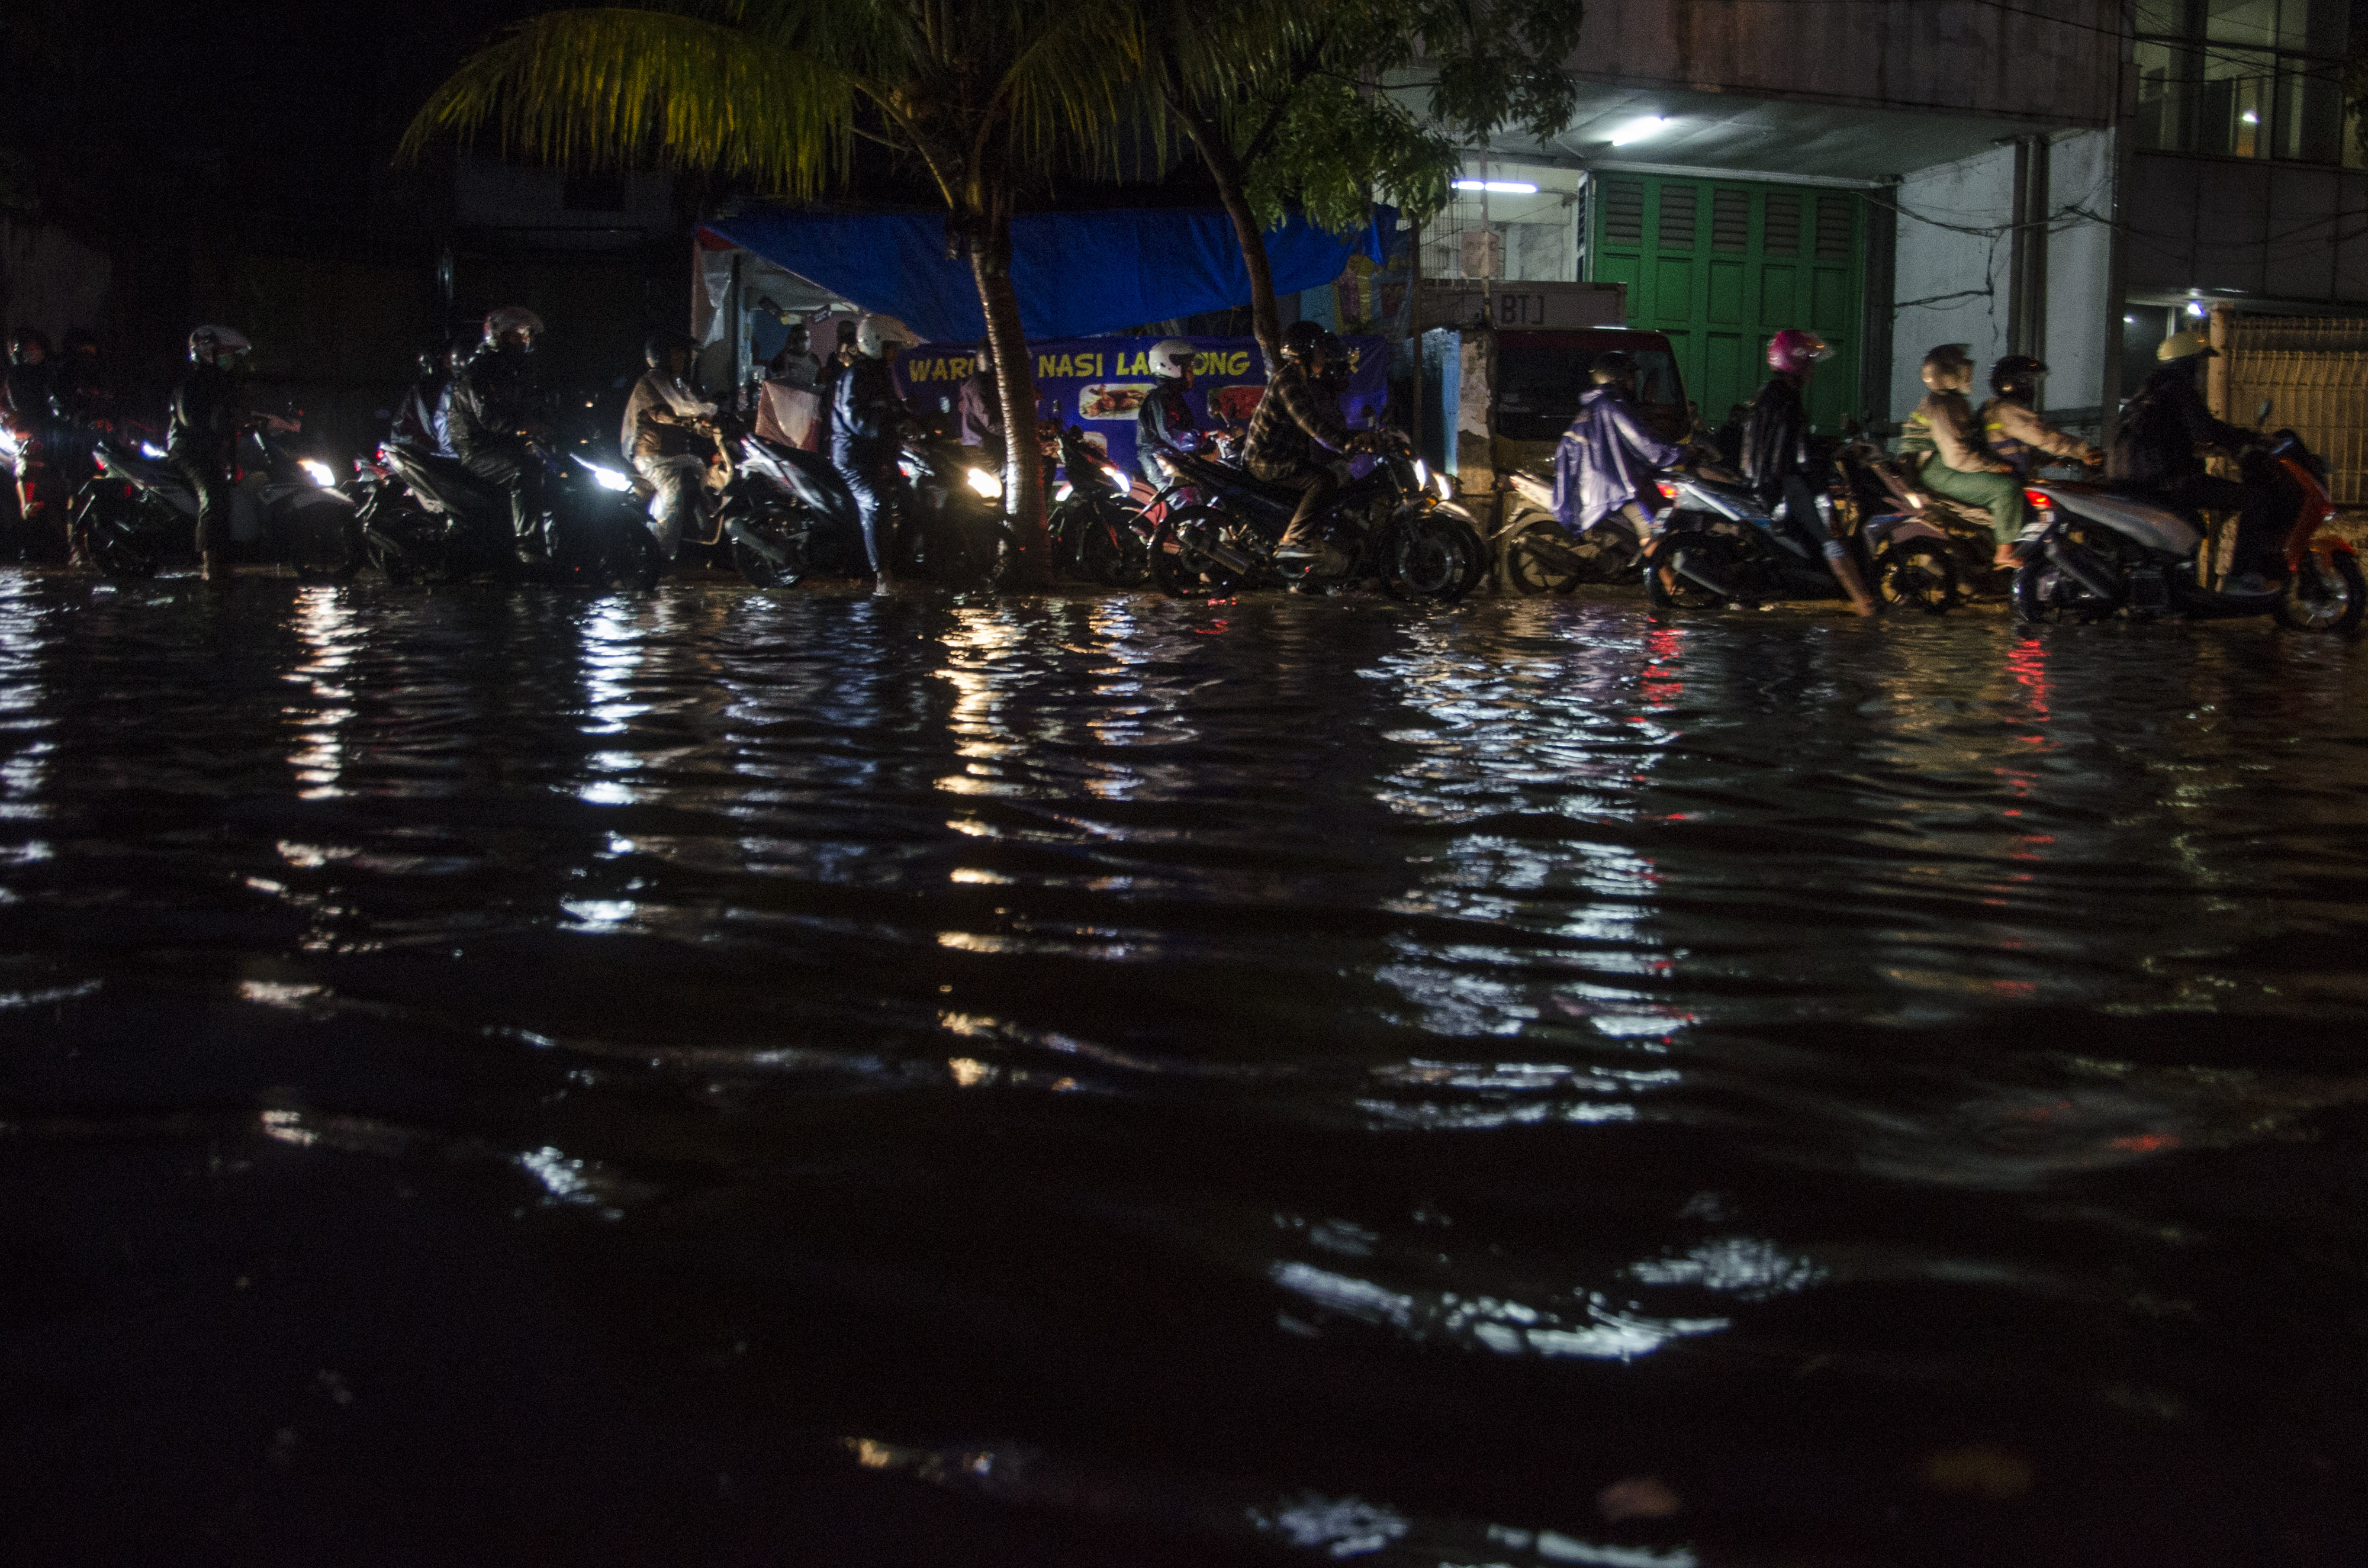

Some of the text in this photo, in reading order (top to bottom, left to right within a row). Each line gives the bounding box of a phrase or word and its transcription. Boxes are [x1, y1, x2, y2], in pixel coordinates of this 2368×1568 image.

[909, 351, 1250, 382] WAR NASI LAONG
